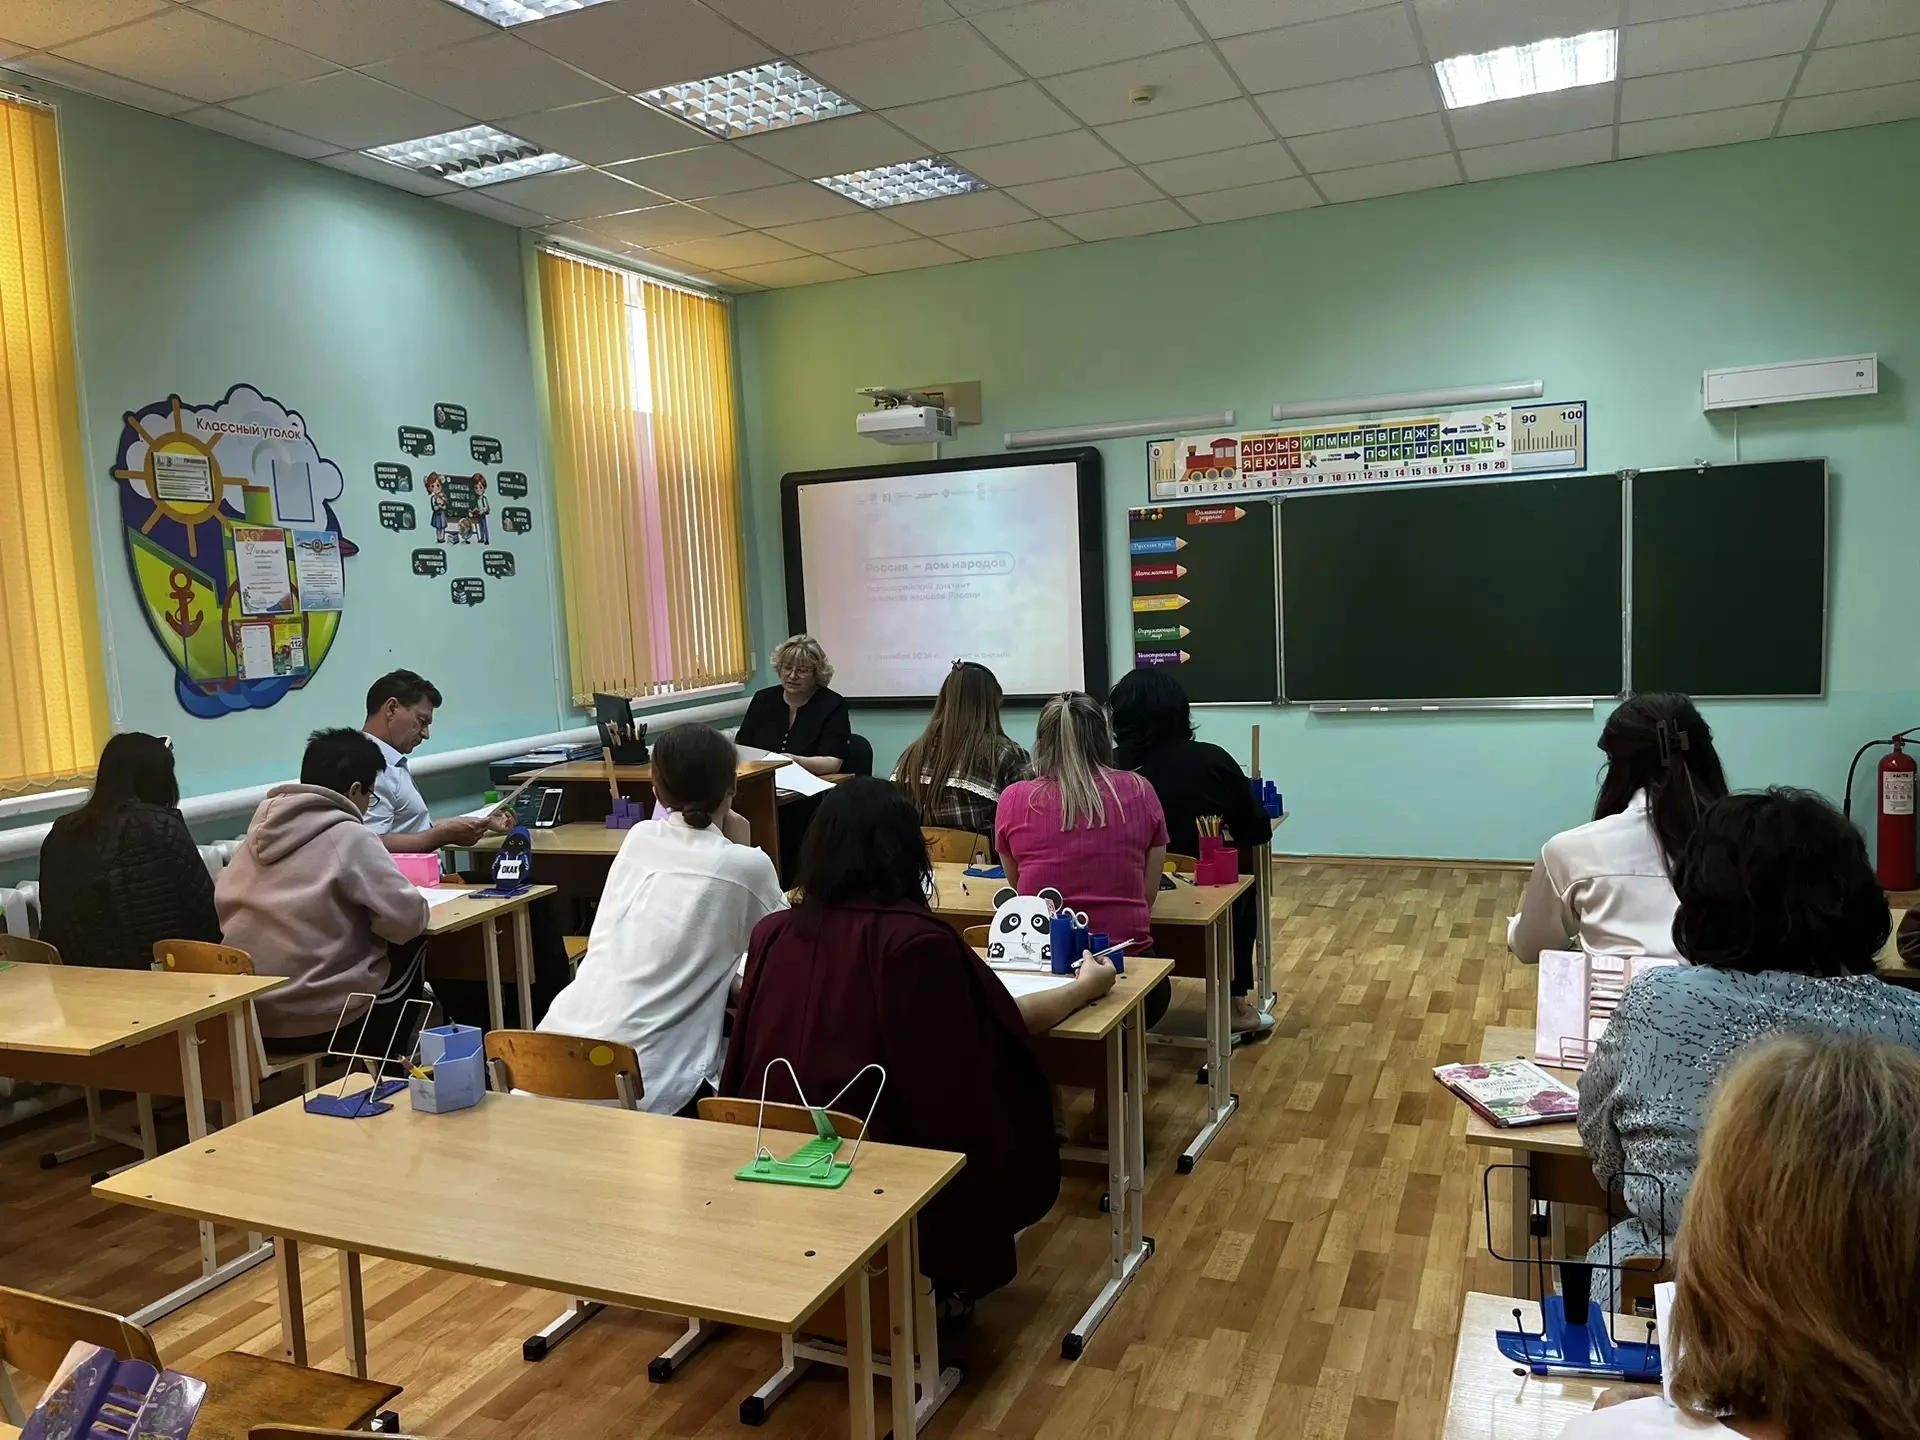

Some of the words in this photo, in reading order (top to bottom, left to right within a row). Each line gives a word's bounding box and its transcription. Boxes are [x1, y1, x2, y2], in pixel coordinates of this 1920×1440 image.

[1522, 414, 1536, 424] 90
[1561, 410, 1582, 420] 100
[196, 418, 260, 436] Классный
[262, 427, 301, 440] уголок
[502, 865, 518, 874] ОКАК
